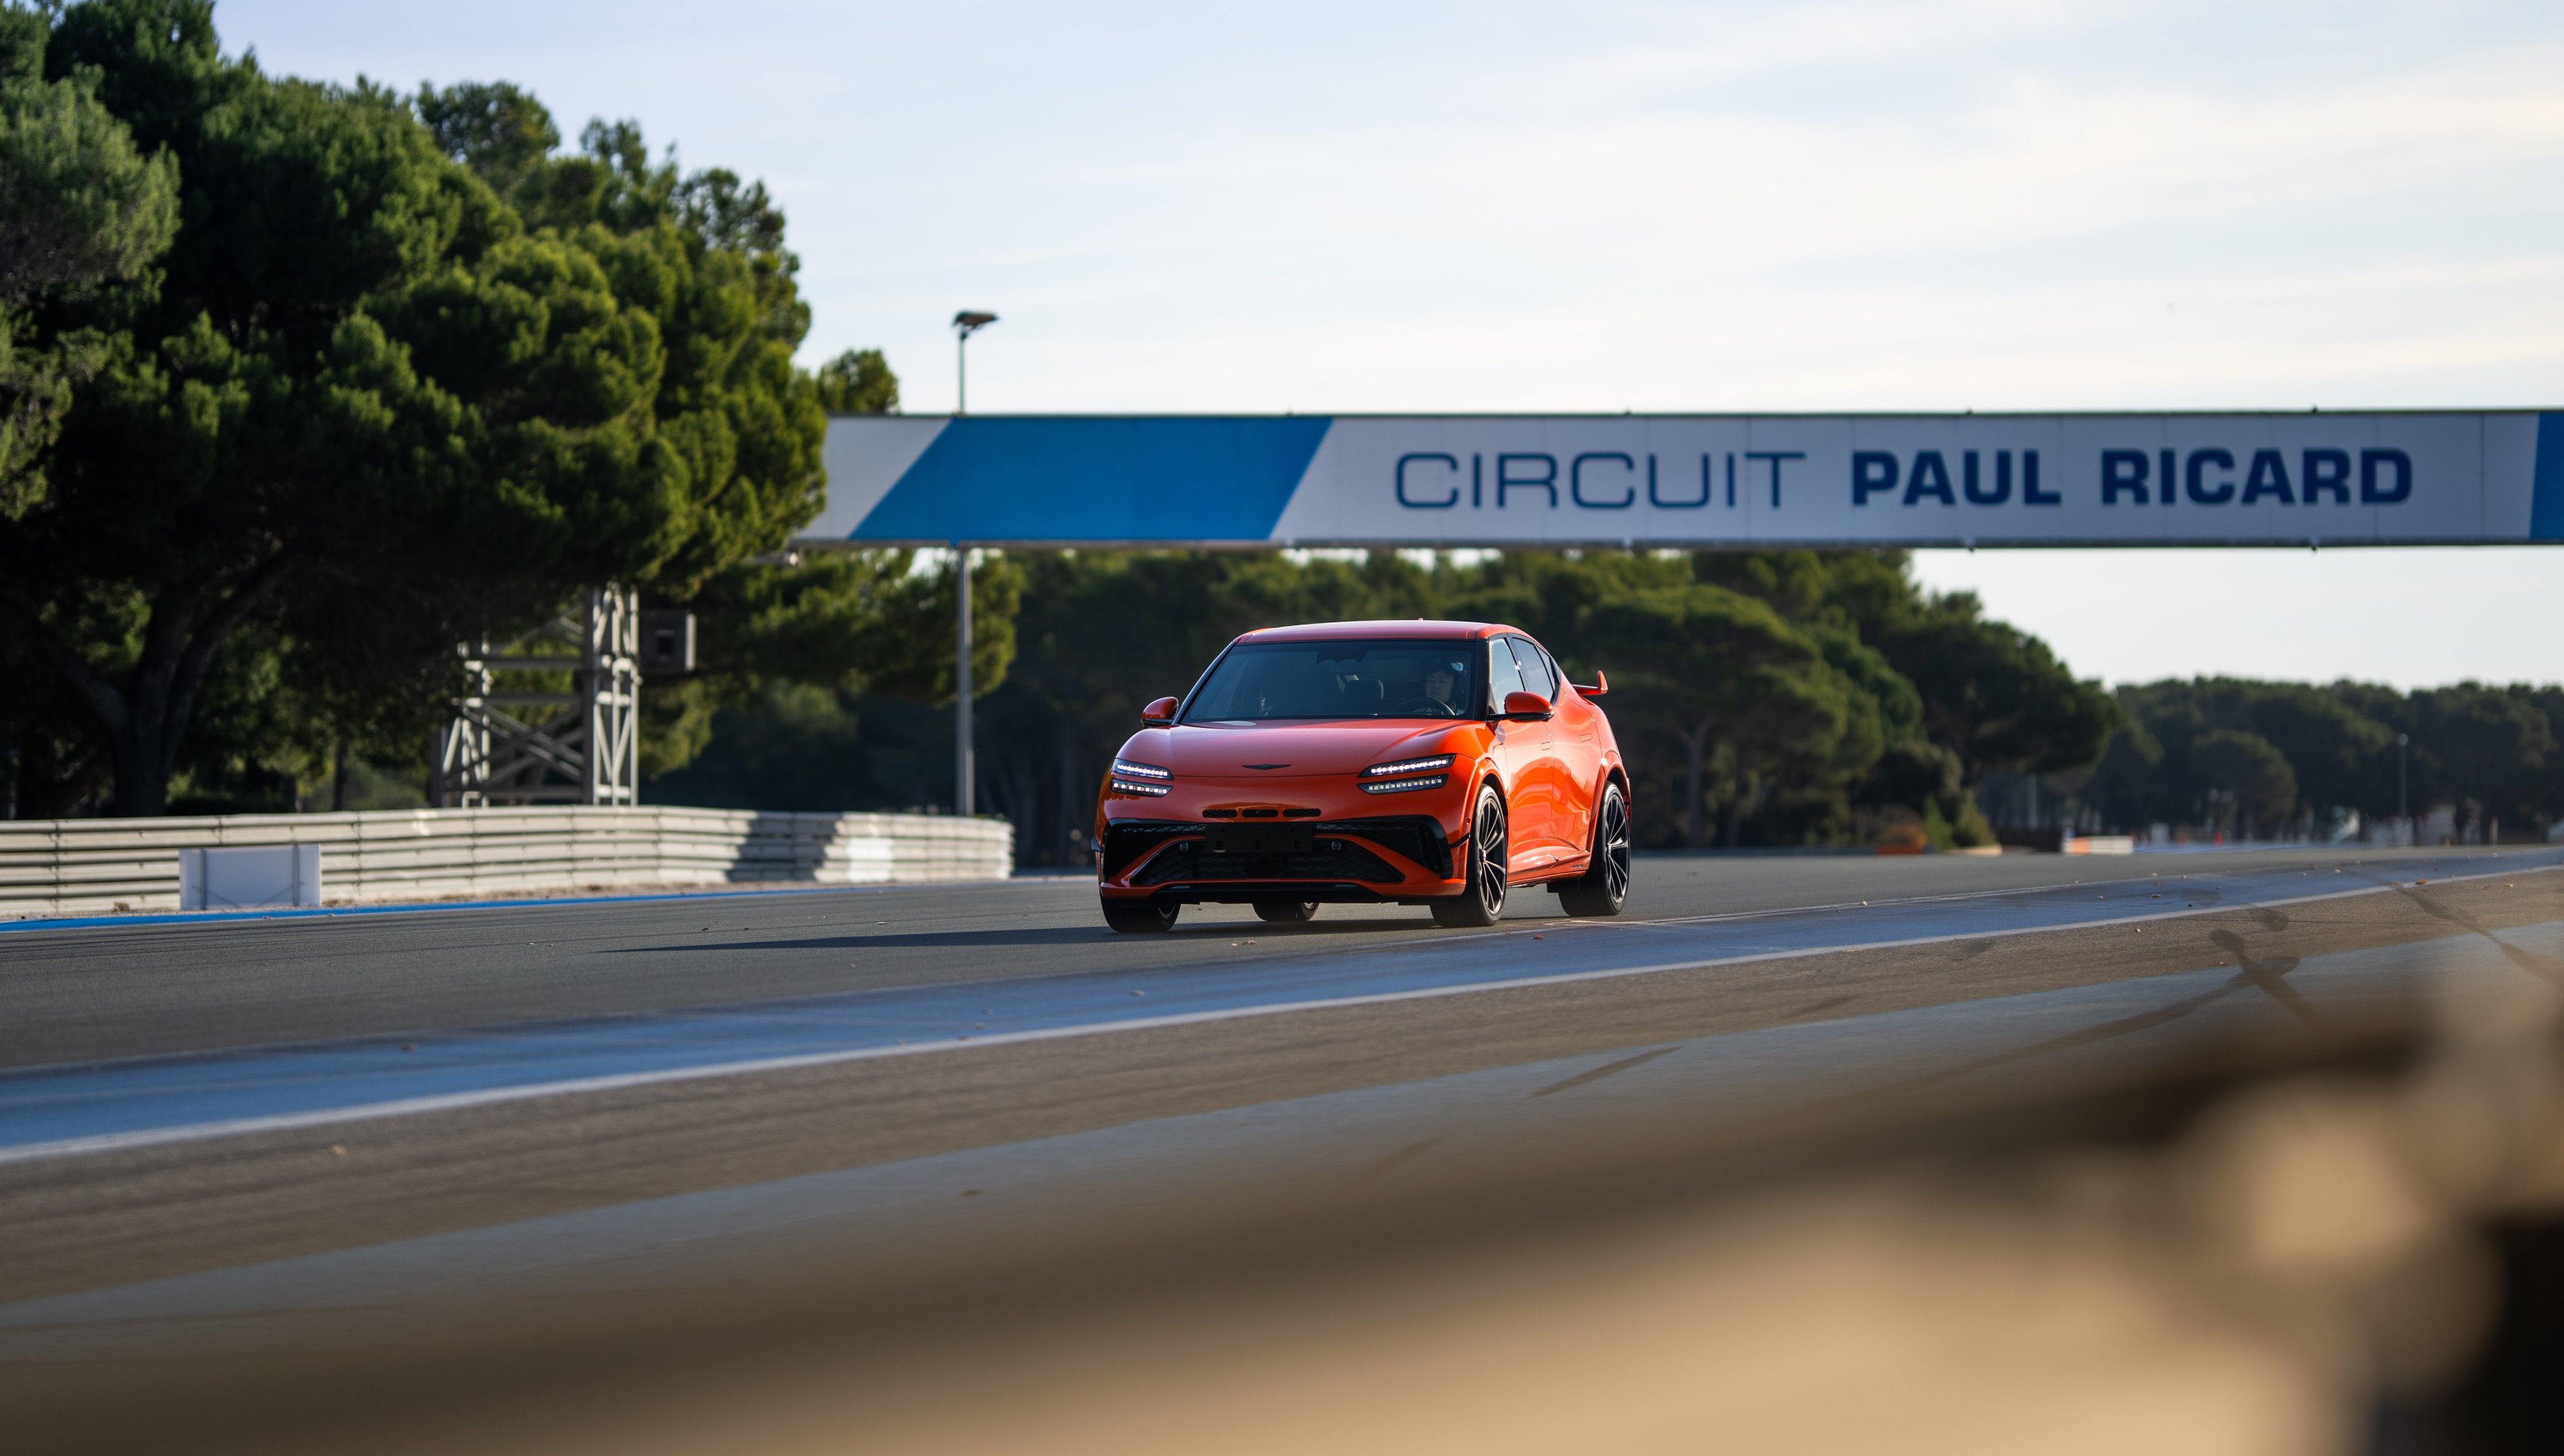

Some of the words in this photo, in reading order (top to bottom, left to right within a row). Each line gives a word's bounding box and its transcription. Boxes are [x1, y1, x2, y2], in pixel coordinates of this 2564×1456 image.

[1395, 452, 1807, 509] CIRCUIT
[1851, 449, 2062, 507] PAUL
[2099, 447, 2414, 507] RICARD
